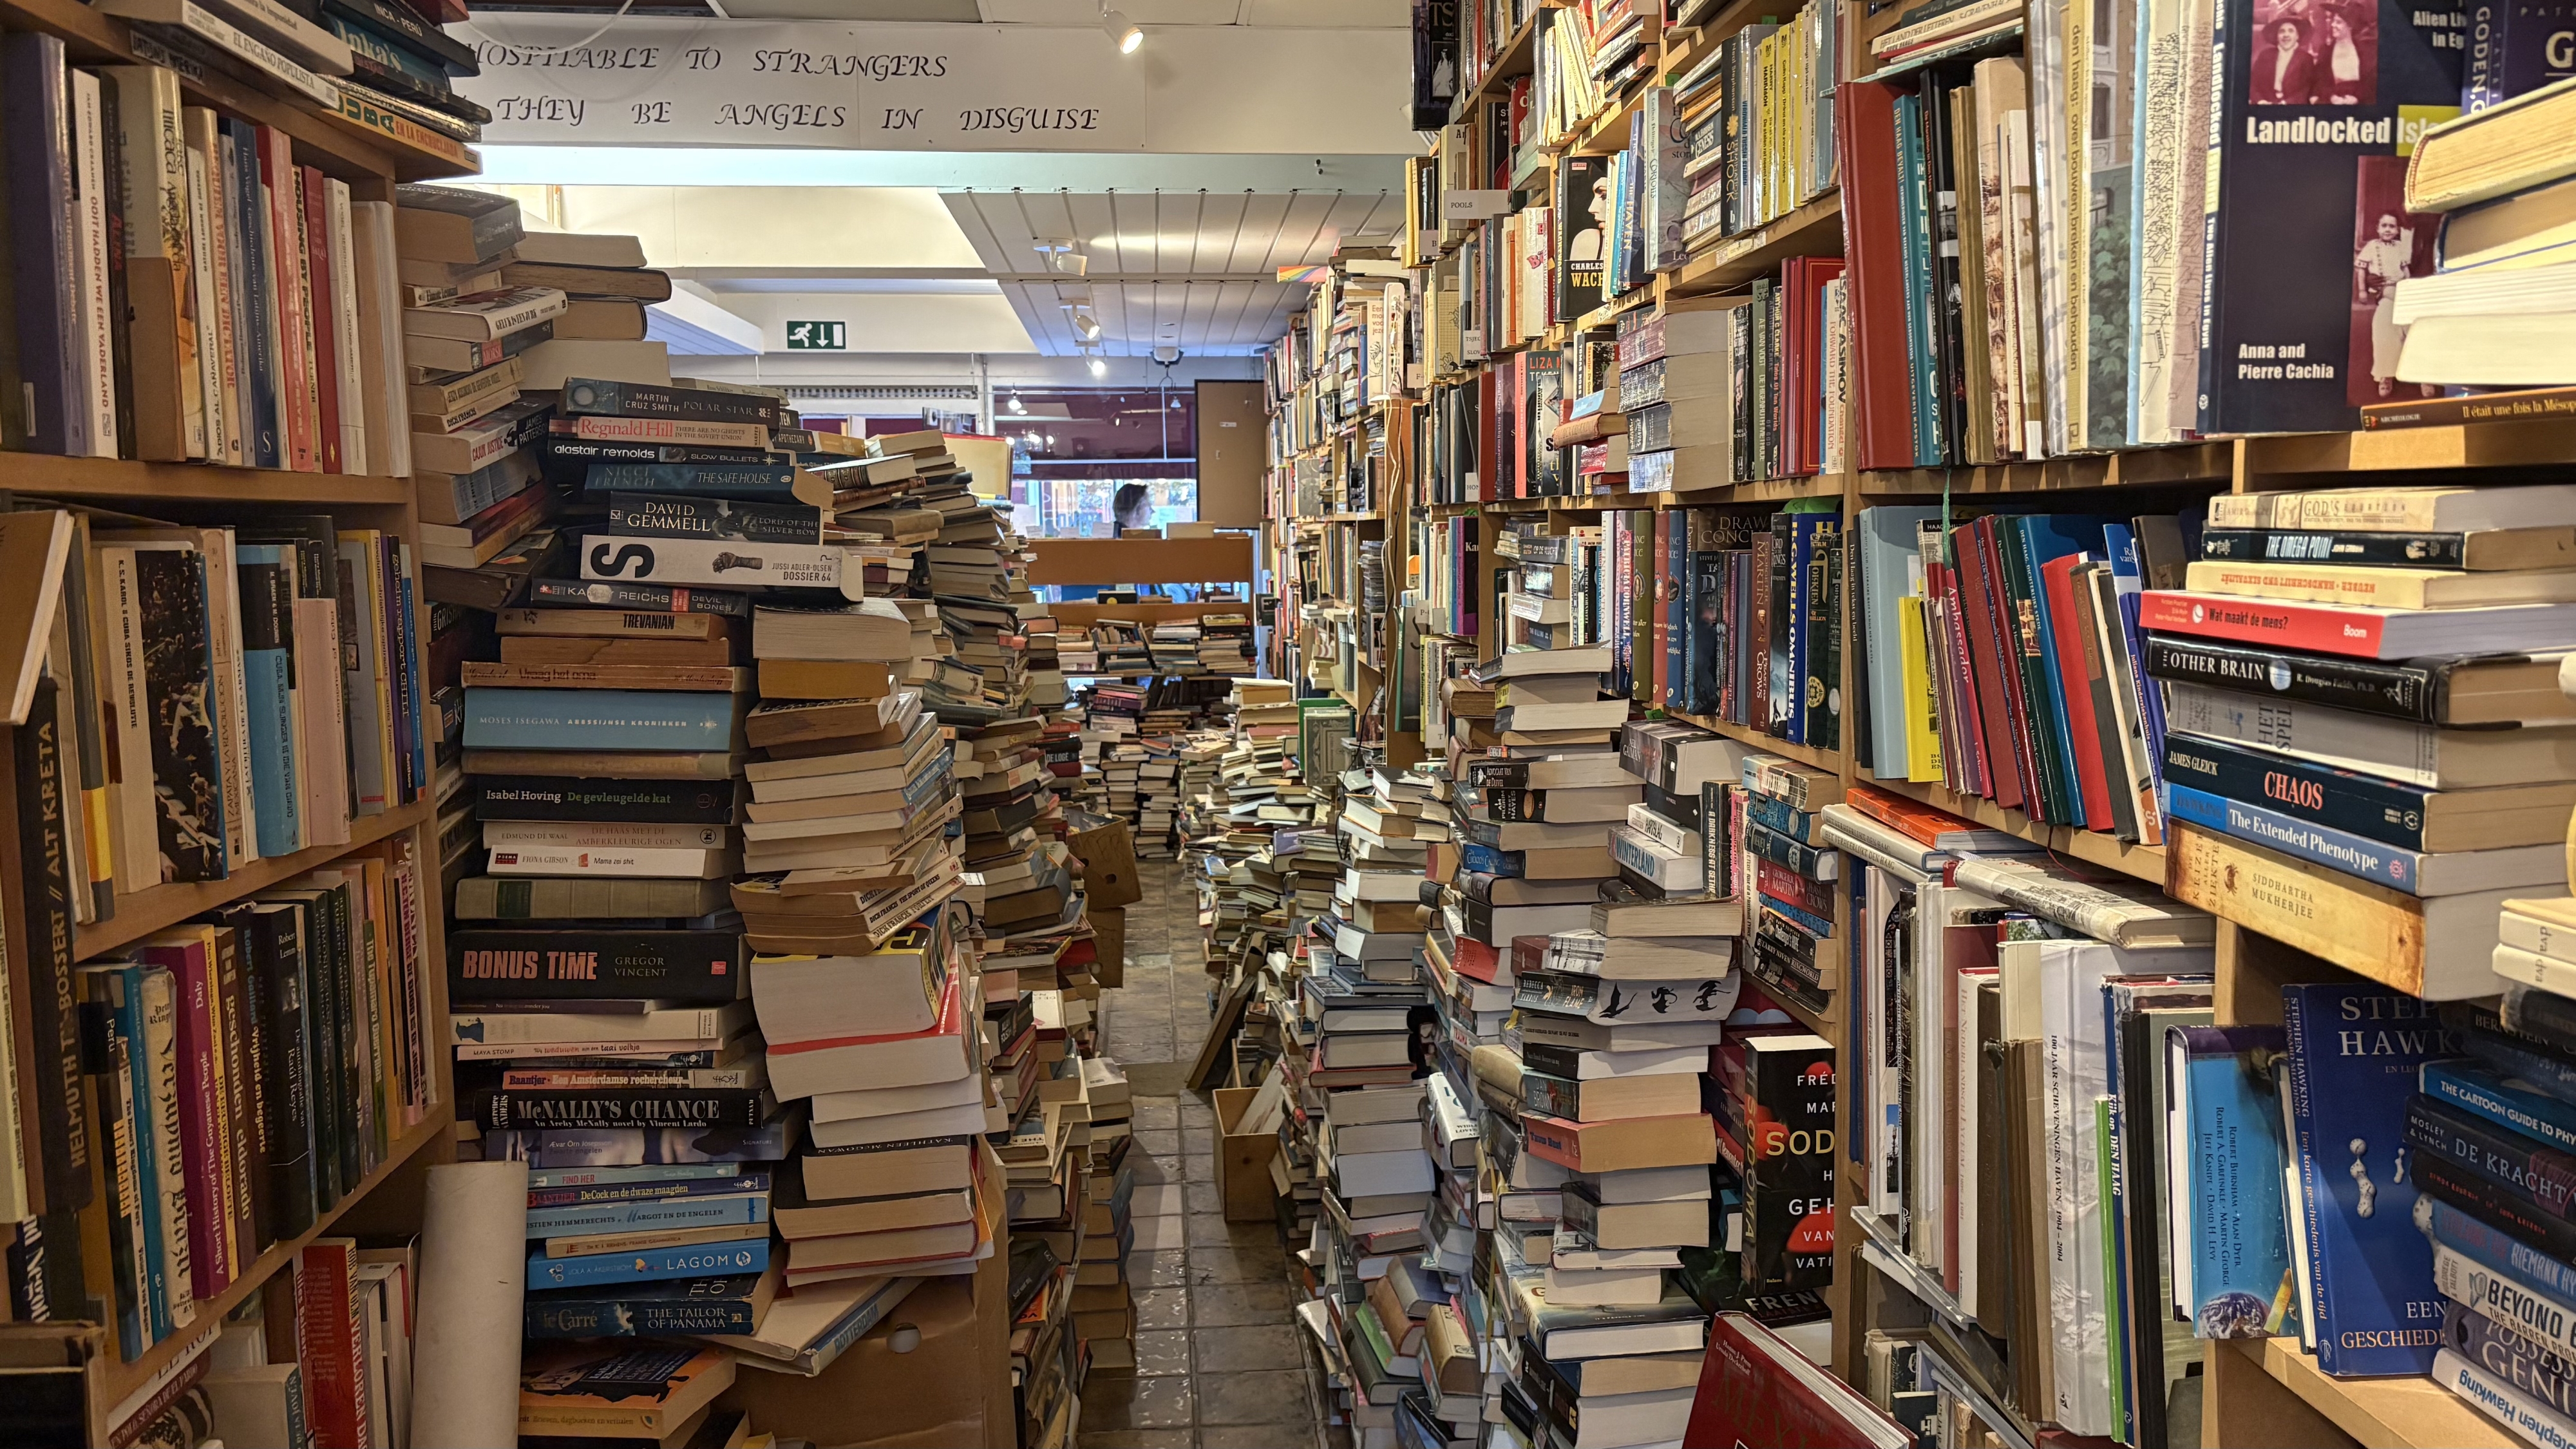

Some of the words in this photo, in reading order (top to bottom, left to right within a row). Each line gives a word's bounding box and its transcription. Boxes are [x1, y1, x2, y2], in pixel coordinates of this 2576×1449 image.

[375, 5, 395, 23] INCA
[401, 14, 423, 37] PERÚ
[2072, 24, 2081, 56] den
[233, 30, 243, 47] EL
[245, 35, 275, 67] ENGAÑO
[276, 53, 314, 90] POPULISTA
[685, 48, 721, 70] TO
[753, 49, 947, 79] STRANGERS
[497, 96, 584, 126] THEY
[632, 102, 670, 124] BE
[715, 104, 846, 129] ANGELS
[882, 108, 923, 129] IN
[960, 108, 1099, 132] DISGUISE
[2246, 117, 2391, 144] Landlocked
[1726, 143, 1735, 203] SHOCK
[91, 196, 99, 227] OOIT
[93, 229, 102, 281] HADDEN
[294, 171, 305, 254] HOUSING
[301, 285, 312, 351] PEOPLE
[95, 284, 104, 303] WE
[2070, 272, 2078, 292] en
[97, 306, 105, 331] EEN
[2070, 295, 2079, 371] behouden
[2239, 344, 2275, 359] Anna
[2278, 343, 2305, 359] and
[99, 334, 109, 408] VADERLAND
[2239, 363, 2283, 379] Pierre
[2286, 363, 2334, 379] Cachia
[625, 400, 649, 410] CRUZ
[650, 402, 679, 412] SMITH
[636, 393, 670, 402] MARTIN
[684, 401, 721, 412] POLAR
[726, 404, 753, 415] STAR
[581, 418, 642, 440] Reginald
[646, 421, 673, 437] Hill
[554, 445, 599, 457] alastair
[603, 447, 655, 459] reynolds
[720, 455, 758, 463] BULLETS
[697, 472, 715, 483] THE
[716, 473, 737, 483] SAFE
[739, 473, 771, 484] HOUSE
[645, 502, 695, 515] DAVID
[627, 513, 712, 531] GEMMELL
[784, 571, 820, 582] DOSSIER
[822, 573, 831, 582] 64
[790, 564, 832, 572] ADLER-OLSEN
[620, 591, 669, 602] REICHS
[692, 595, 721, 603] DEVIL
[697, 602, 731, 611] BONES
[623, 614, 675, 630] TREVANIAN
[2209, 608, 2222, 621] Wat
[2224, 610, 2248, 625] maakt
[2251, 613, 2261, 625] de
[2262, 614, 2289, 630] mens?
[1947, 587, 1969, 683] Ambassador
[2344, 624, 2367, 639] Boom
[1787, 627, 1796, 719] OMNIBUS
[2170, 652, 2217, 674] OTHER
[2221, 660, 2264, 681] BRAIN
[480, 716, 511, 724] MOSES
[515, 717, 560, 725] ISEGAWA
[2169, 750, 2190, 770] JAMES
[2191, 756, 2218, 776] GLEICK
[486, 790, 519, 800] Isabel
[521, 791, 561, 804] Hoving
[567, 792, 582, 802] De
[584, 792, 650, 806] gevleugelde
[652, 793, 670, 803] kat
[2264, 772, 2323, 810] CHAOS
[2230, 809, 2251, 830] The
[2253, 813, 2307, 847] Extended
[2310, 832, 2378, 871] Phenotype
[1616, 837, 1654, 877] WINTERLAND
[2252, 873, 2314, 902] SIDDHARTHA
[2252, 888, 2313, 919] MUKHERJEE
[462, 951, 538, 979] BONUS
[547, 952, 598, 980] TIME
[614, 968, 668, 977] VINCENT
[615, 956, 665, 965] GREGOR
[1761, 941, 1776, 958] LARRY
[1776, 949, 1791, 964] NIVEN
[1792, 960, 1819, 981] RINGWORLD
[196, 980, 204, 1009] Daly
[2291, 997, 2306, 1056] STEPHEN
[202, 1051, 213, 1101] People
[2297, 1057, 2309, 1118] HAWKING
[225, 996, 243, 1121] geschonden
[237, 1128, 249, 1220] eldorado
[630, 1100, 719, 1119] CHANCE
[2108, 1093, 2116, 1115] Kijk
[2440, 1080, 2459, 1099] THE
[2459, 1086, 2506, 1119] CARTOON
[2508, 1106, 2539, 1130] GUIDE
[2540, 1118, 2555, 1135] TO
[204, 1103, 215, 1156] Guyanese
[2108, 1117, 2116, 1130] op
[2110, 1134, 2119, 1158] DEN
[2301, 1130, 2310, 1151] Een
[205, 1157, 216, 1175] The
[1745, 1095, 1757, 1239] SODOMA
[2304, 1154, 2313, 1179] korte
[2455, 1137, 2481, 1159] DE
[2486, 1152, 2567, 1205] KRACHT
[562, 1175, 578, 1184] FIND
[580, 1174, 595, 1184] HER
[2112, 1161, 2121, 1196] HAAG
[208, 1186, 223, 1231] History
[2306, 1181, 2320, 1260] geschiedenis
[211, 1235, 223, 1262] Short
[216, 1264, 224, 1274] A
[667, 1255, 729, 1270] LAGOM
[2315, 1262, 2323, 1283] van
[2317, 1285, 2323, 1298] de
[648, 1308, 674, 1318] THE
[677, 1307, 726, 1318] TAILOR
[2488, 1277, 2562, 1339] BEYOND
[648, 1318, 665, 1329] OF
[668, 1317, 726, 1329] PANAMA
